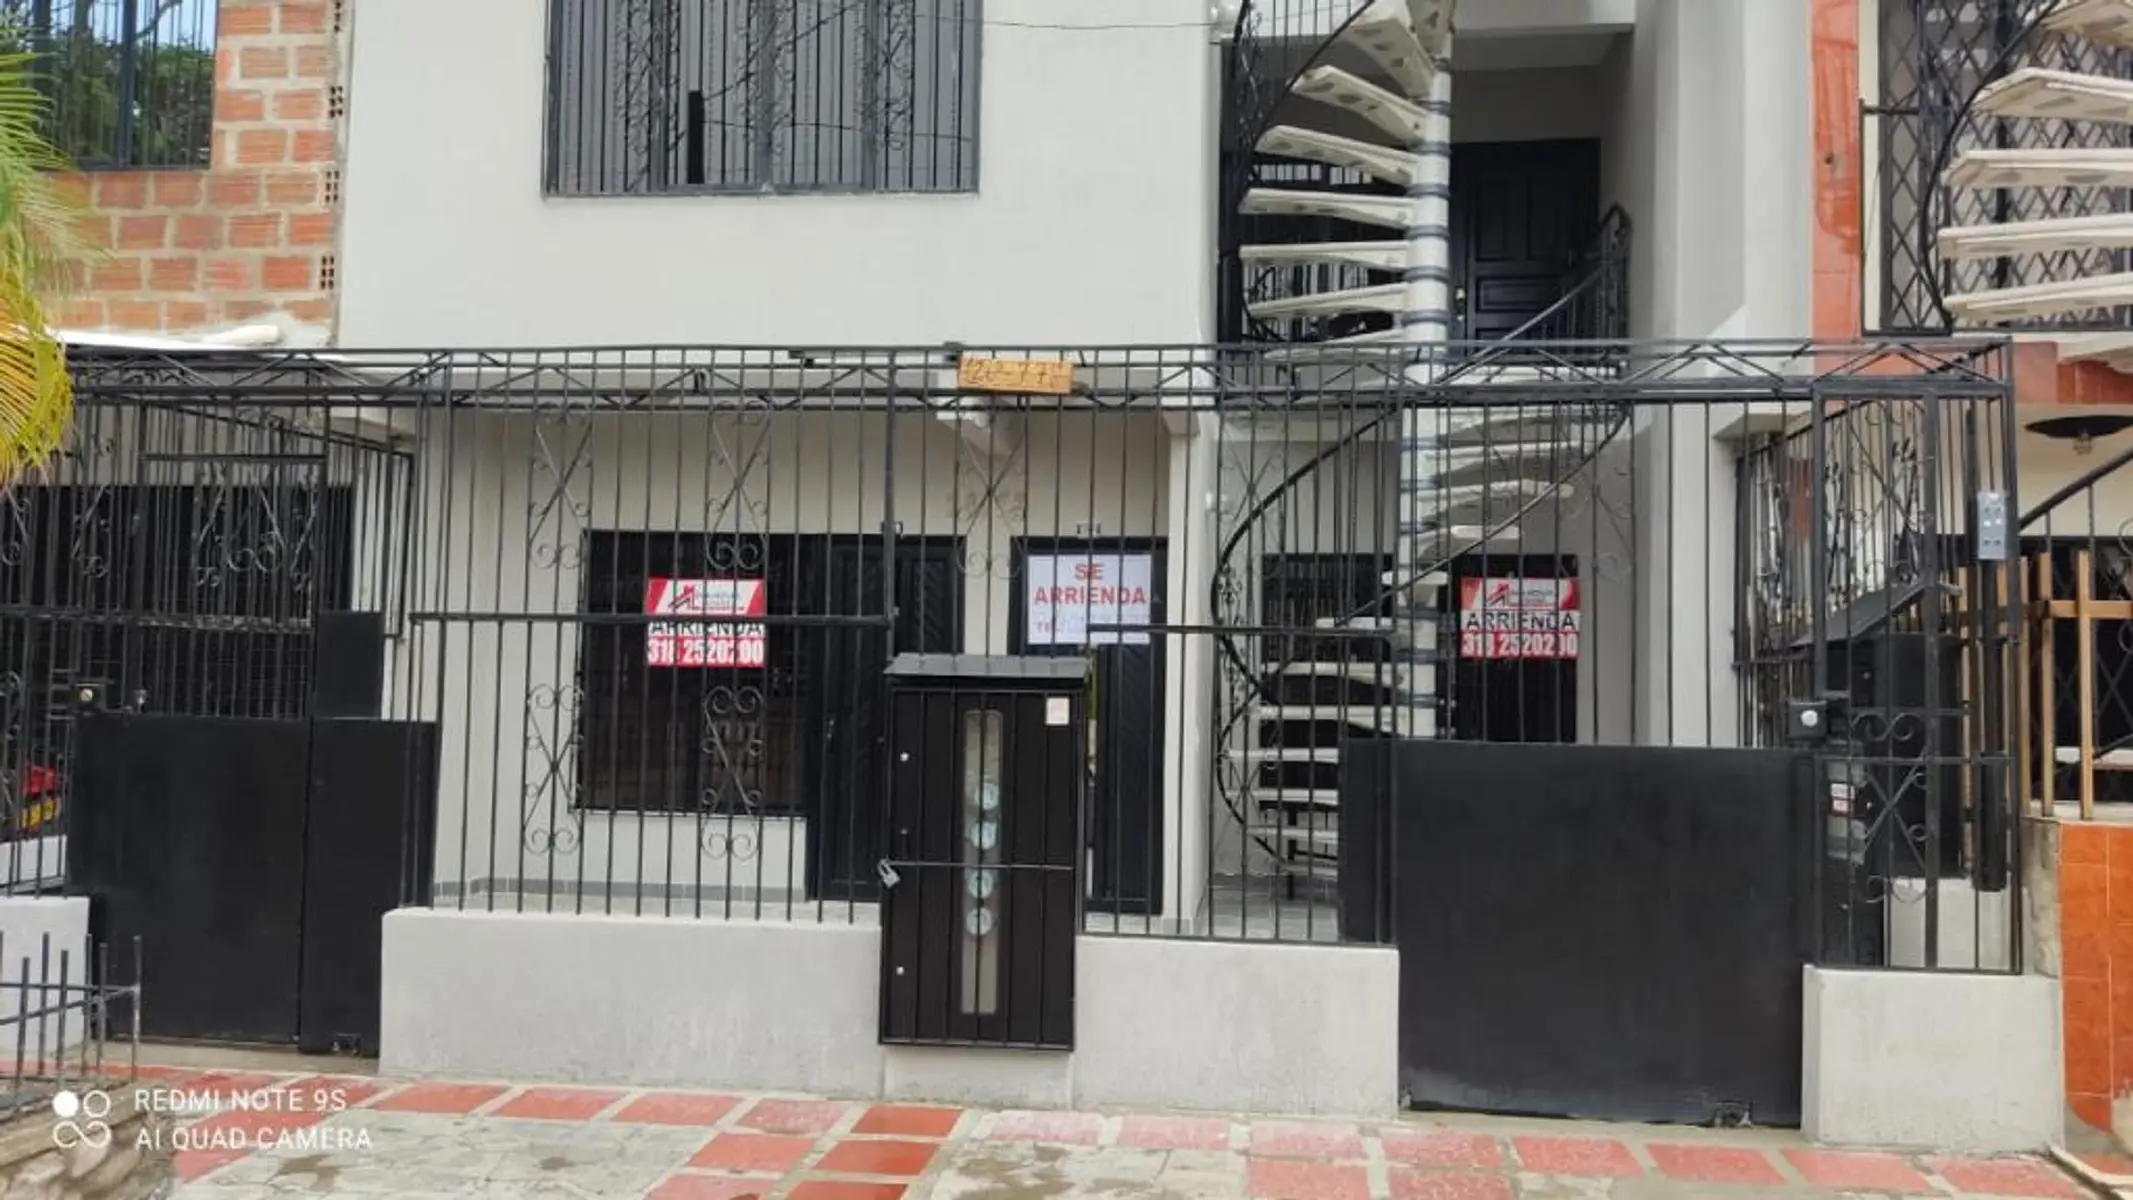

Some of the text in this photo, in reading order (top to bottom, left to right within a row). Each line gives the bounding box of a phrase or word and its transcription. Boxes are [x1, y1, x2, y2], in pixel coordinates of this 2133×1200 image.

[1074, 563, 1104, 580] SE
[1034, 586, 1147, 605] ARRIENDA
[1466, 611, 1575, 630] ARRIENDA
